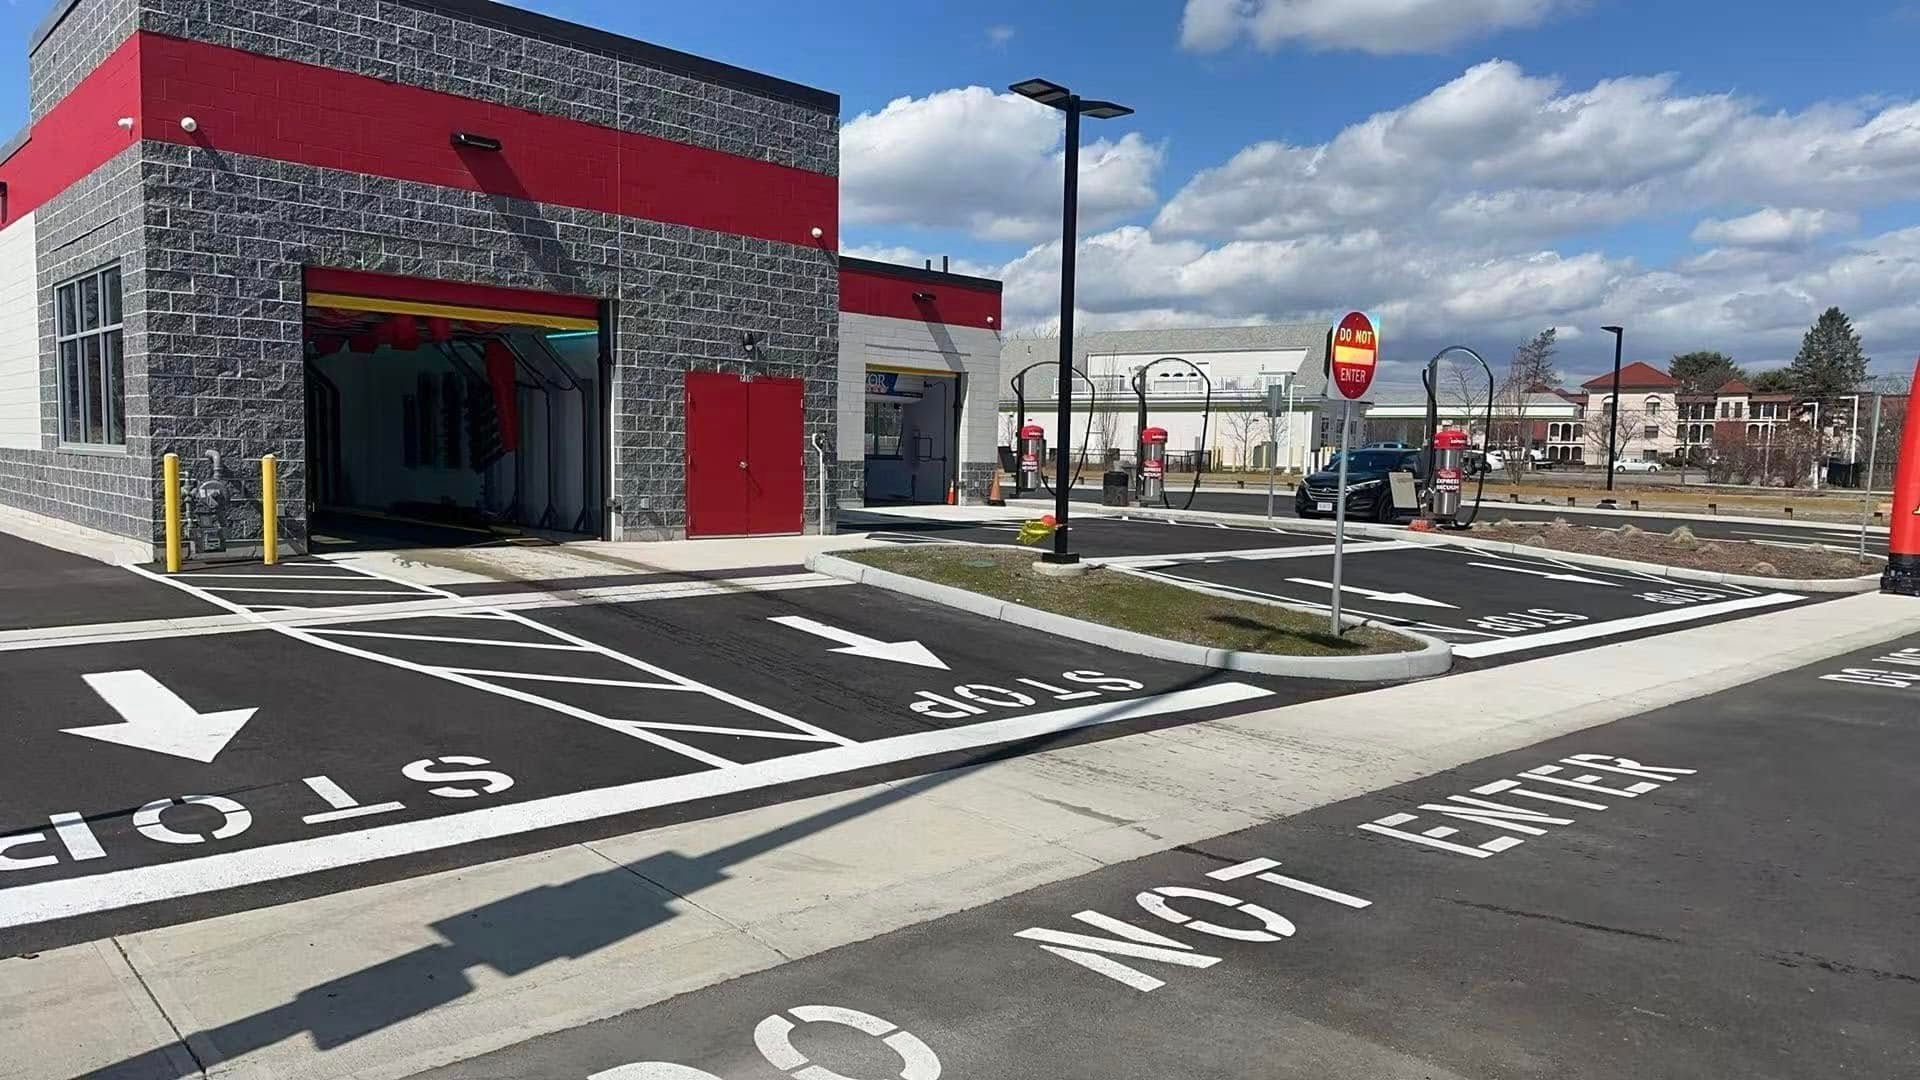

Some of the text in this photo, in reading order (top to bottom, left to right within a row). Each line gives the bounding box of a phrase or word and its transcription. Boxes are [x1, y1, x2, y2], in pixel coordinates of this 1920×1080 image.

[1340, 327, 1372, 345] DO NOT
[1340, 367, 1366, 383] ENTER
[1466, 608, 1589, 632] STOP
[910, 670, 1144, 719] STOP
[0, 756, 514, 871] STOP
[586, 754, 1697, 1080] O NOT ENTER
